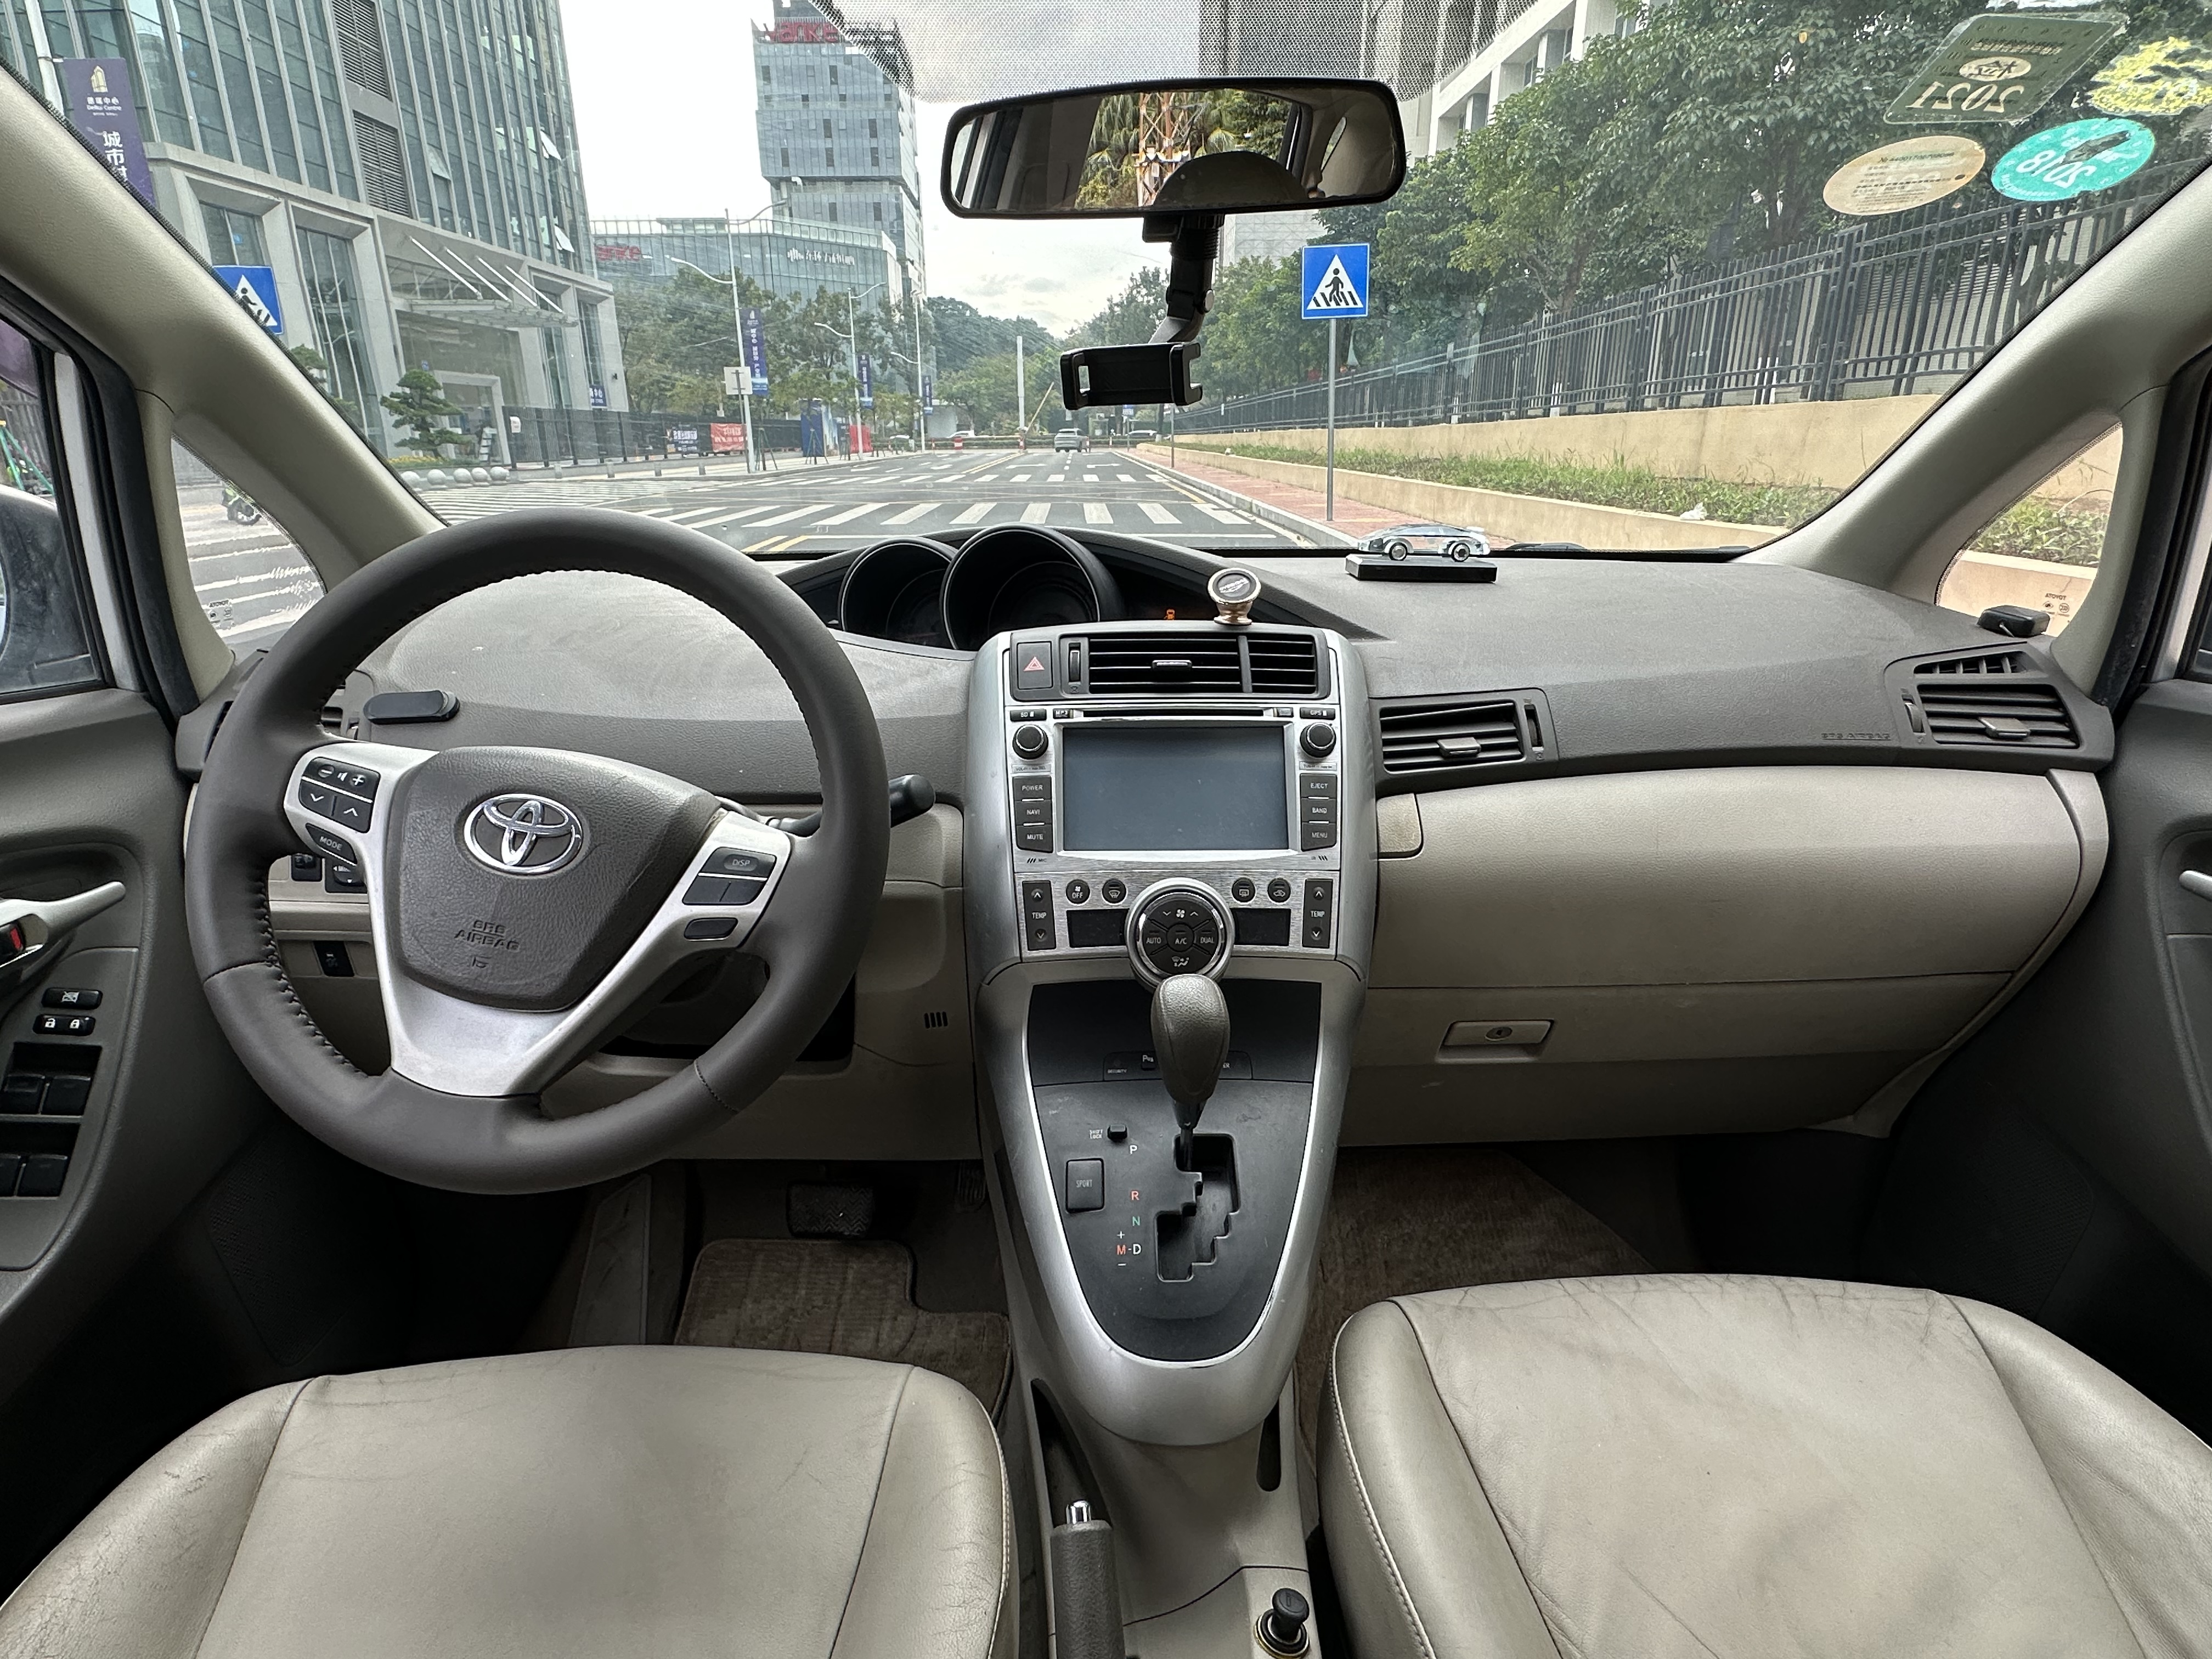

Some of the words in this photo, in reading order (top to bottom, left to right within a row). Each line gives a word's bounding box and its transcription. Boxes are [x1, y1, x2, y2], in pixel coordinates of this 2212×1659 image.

[320, 836, 342, 850] MODE
[1130, 1145, 1137, 1154] P
[1131, 1191, 1139, 1200] R
[1132, 1217, 1140, 1226] N
